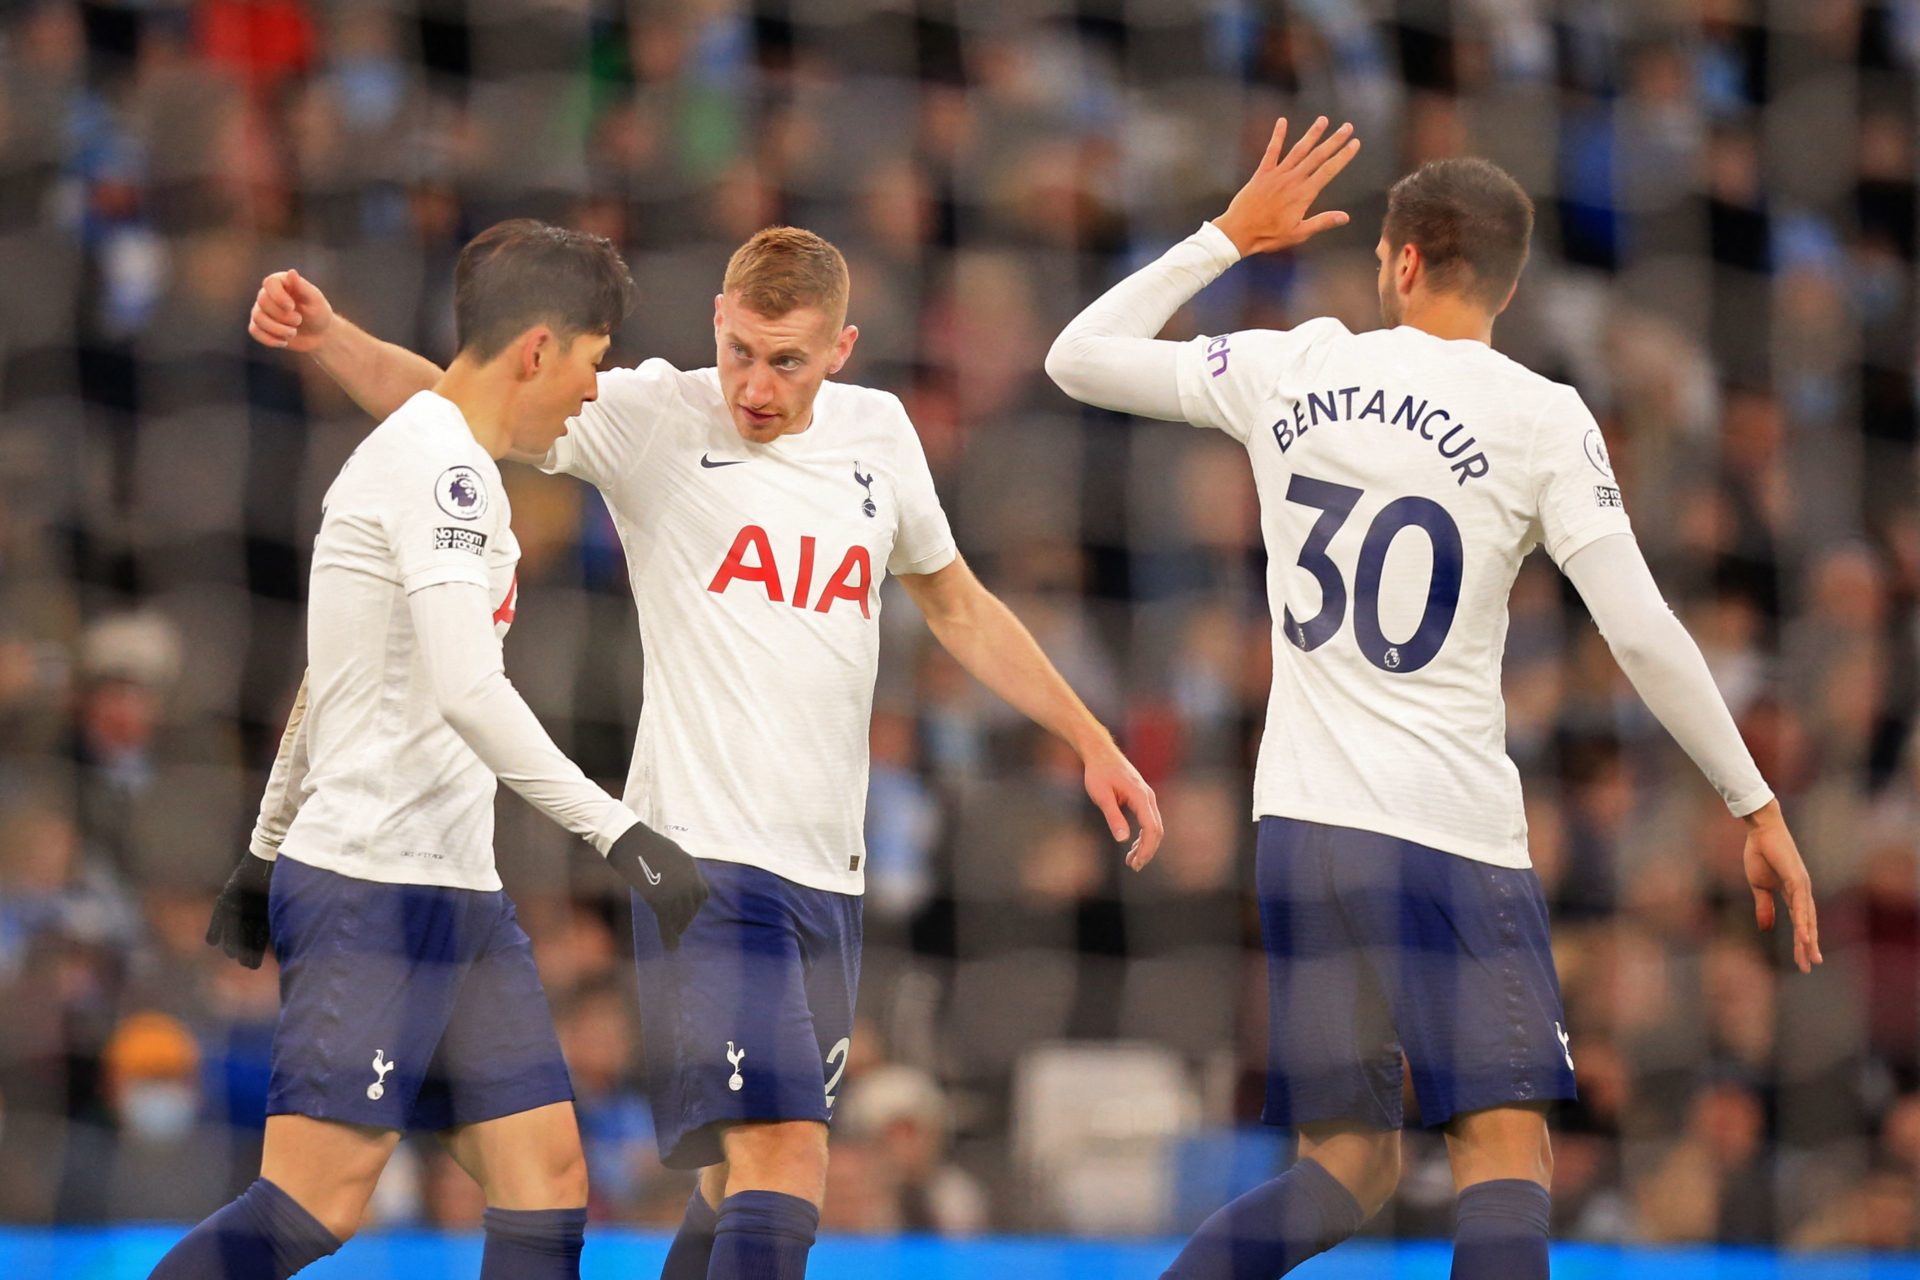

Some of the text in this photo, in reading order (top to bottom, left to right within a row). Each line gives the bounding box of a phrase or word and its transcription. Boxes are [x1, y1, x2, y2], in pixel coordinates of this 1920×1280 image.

[1207, 335, 1231, 378] ch
[1272, 386, 1489, 487] BENTANCUR
[1594, 487, 1609, 499] No
[435, 528, 483, 546] No room
[707, 524, 871, 620] AIA
[1283, 473, 1464, 673] 30
